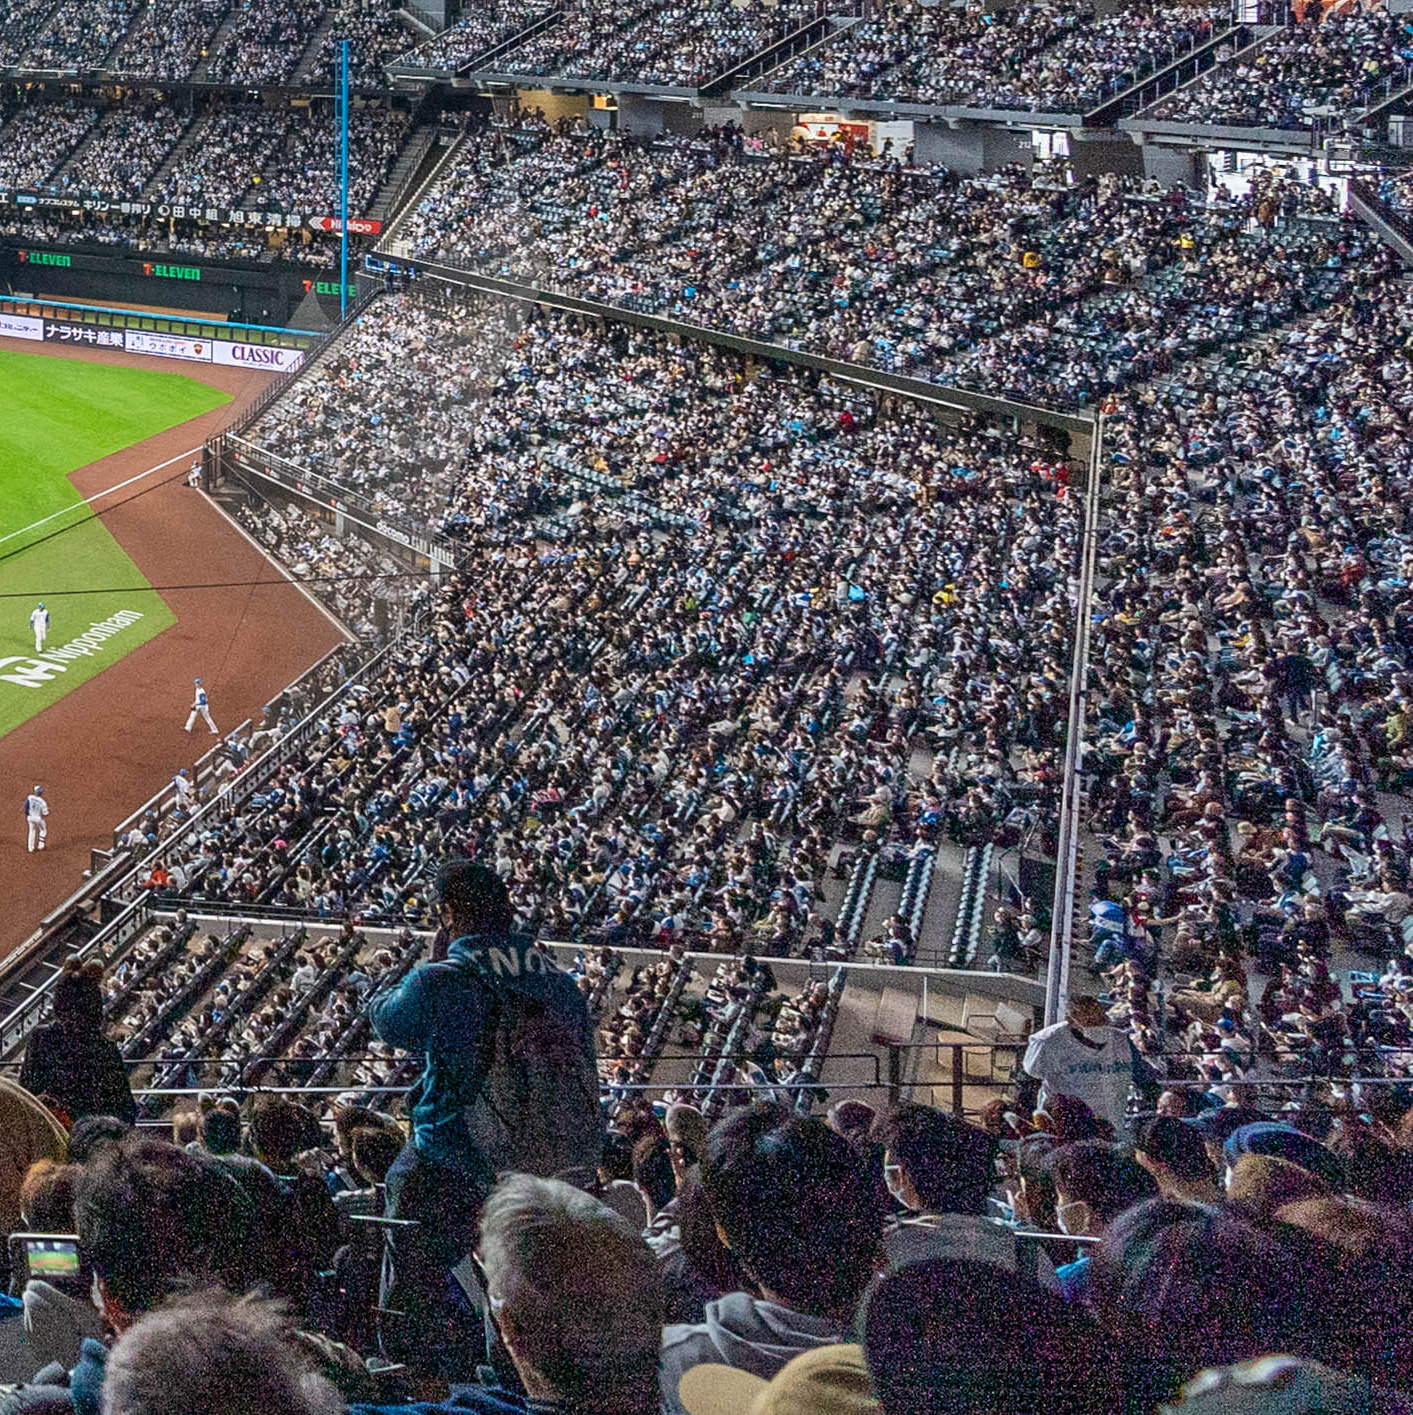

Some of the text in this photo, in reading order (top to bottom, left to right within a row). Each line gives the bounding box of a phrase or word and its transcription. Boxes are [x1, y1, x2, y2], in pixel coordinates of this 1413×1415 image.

[172, 205, 218, 221] 田中組
[228, 209, 302, 227] 旭東清掃
[17, 250, 71, 268] 7-ELEVEN
[142, 263, 201, 281] 7-ELEVEN
[45, 324, 124, 348] ナラサキ産業
[231, 345, 284, 365] CLASSIC
[38, 609, 144, 663] Nipponham
